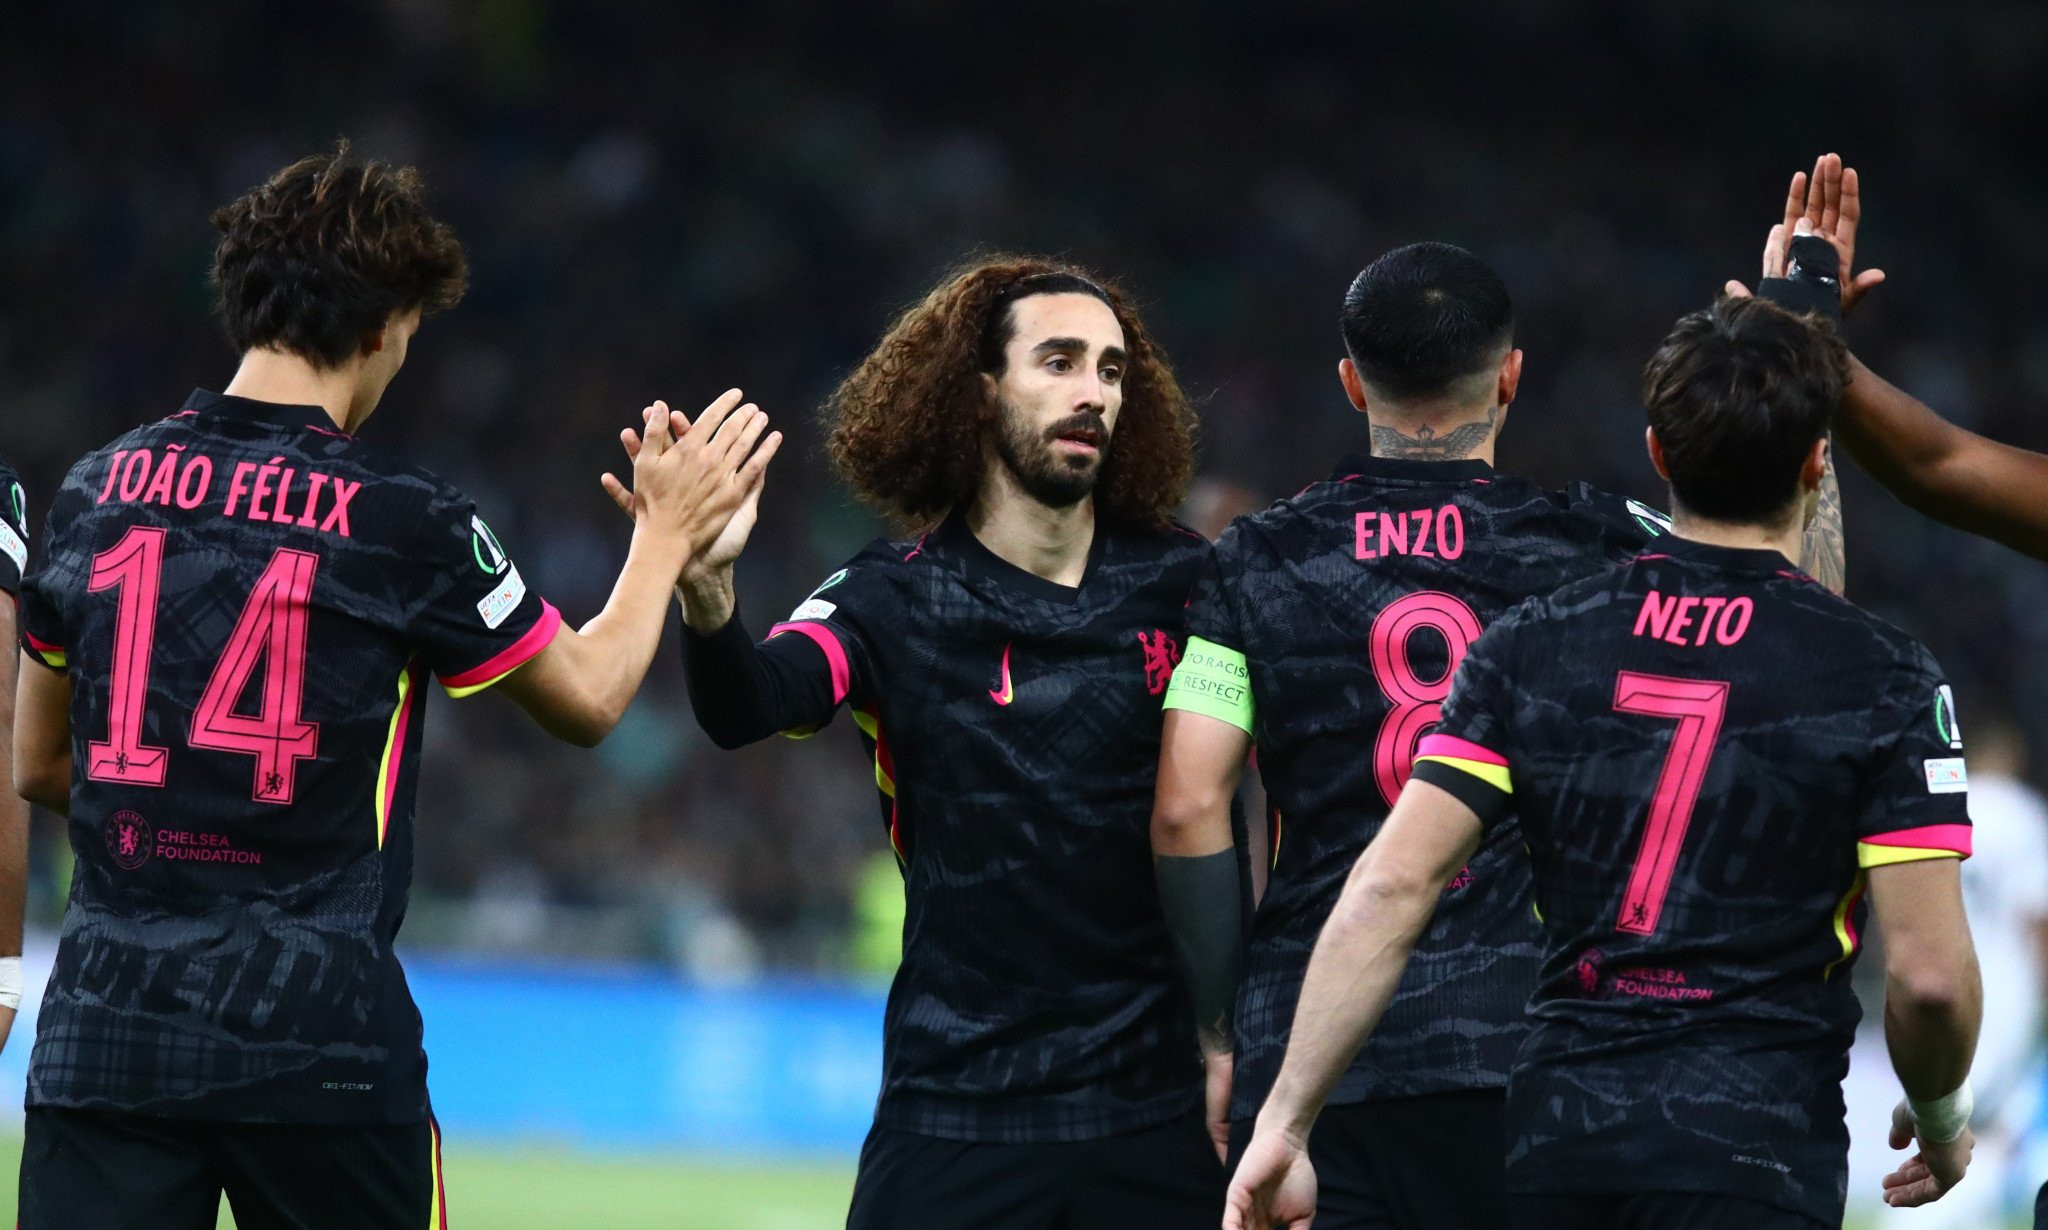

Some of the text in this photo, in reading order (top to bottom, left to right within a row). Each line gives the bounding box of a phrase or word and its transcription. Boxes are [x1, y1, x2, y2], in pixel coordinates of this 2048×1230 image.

[97, 444, 362, 537] JOÃO FÉLIX
[1355, 504, 1465, 560] ENZO
[1633, 590, 1754, 647] NETO
[87, 525, 320, 805] 14
[1184, 675, 1244, 702] RESPECT
[1369, 590, 1484, 809] 8
[1612, 670, 1730, 936] 7
[156, 846, 262, 864] FOUNDATION
[157, 829, 230, 847] CHELSEA
[1616, 979, 1714, 1000] FOUNDATION
